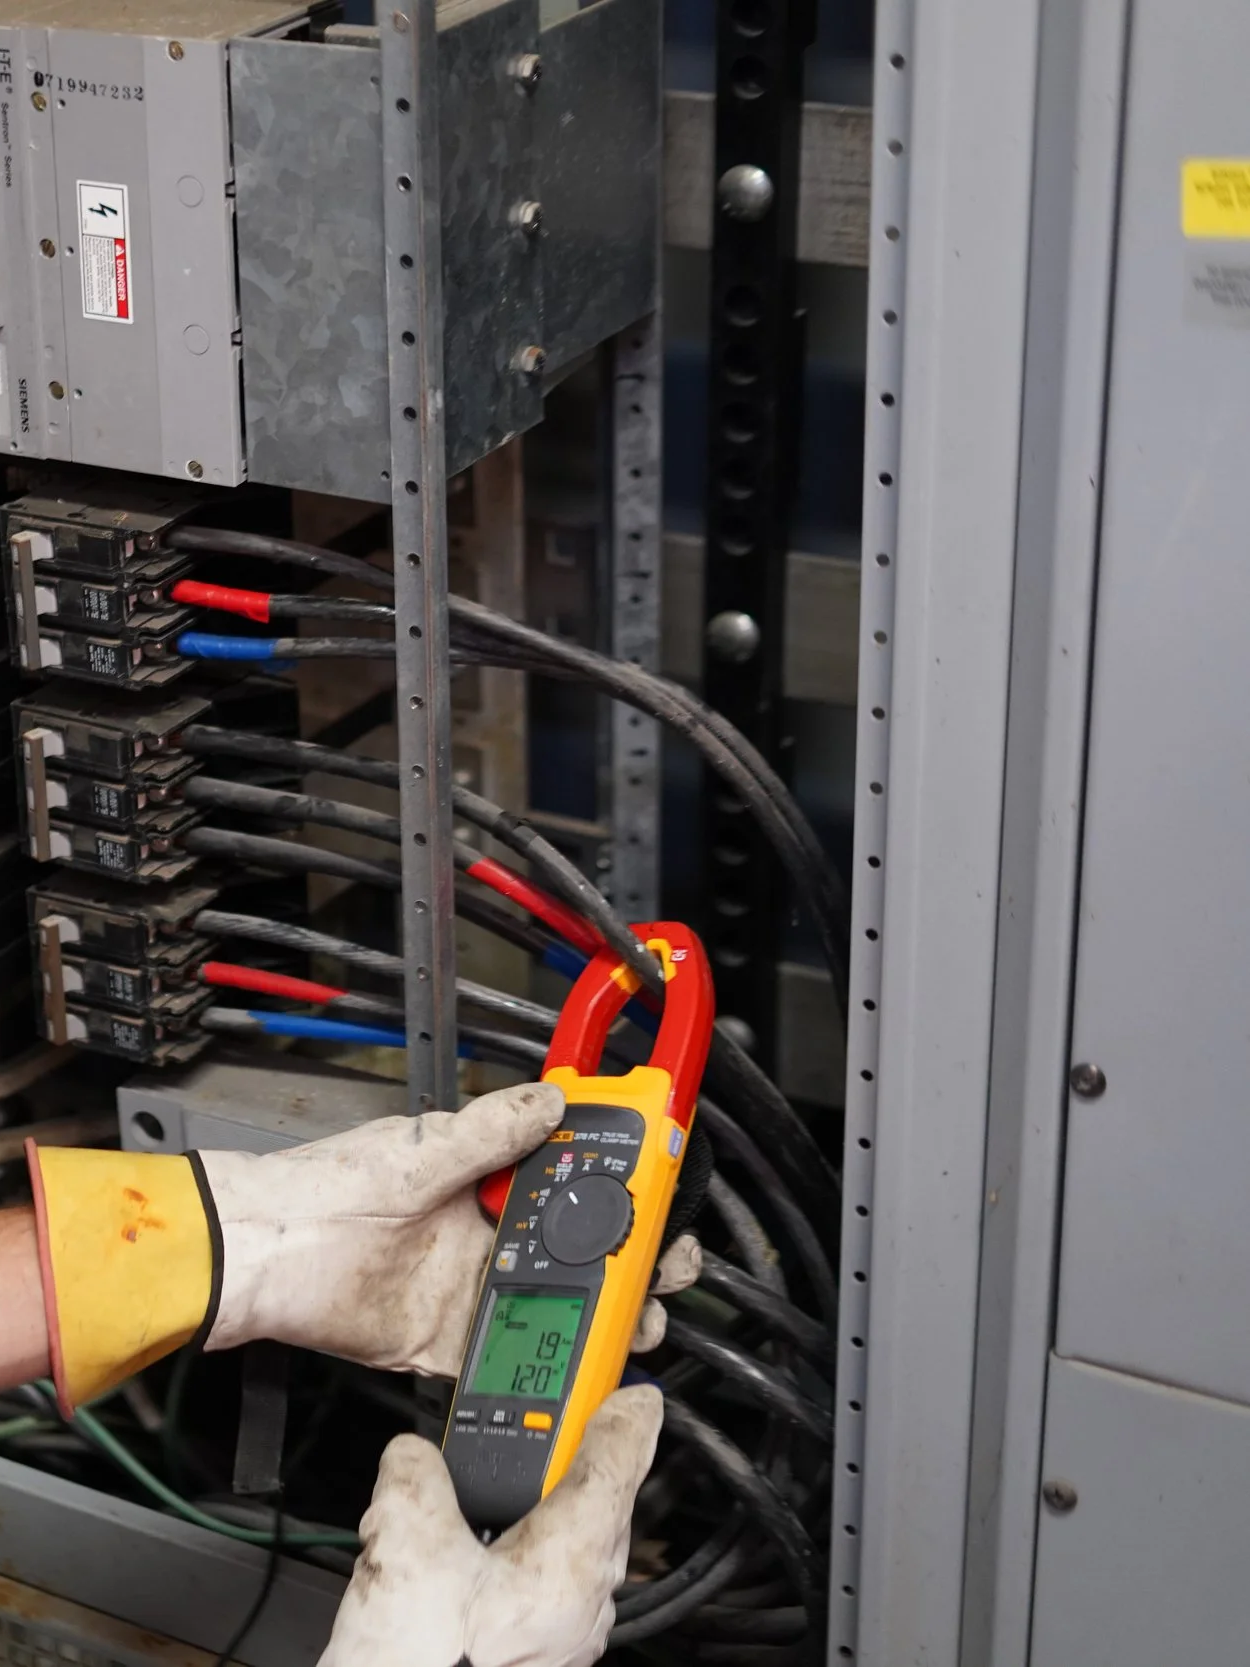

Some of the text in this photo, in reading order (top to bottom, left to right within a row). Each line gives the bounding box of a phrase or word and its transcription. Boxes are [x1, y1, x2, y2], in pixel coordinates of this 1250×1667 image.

[3, 155, 13, 188] Series
[116, 258, 127, 302] DANGER
[17, 378, 30, 433] SIEMENS
[534, 1260, 549, 1270] OFF
[510, 1363, 552, 1394] 120
